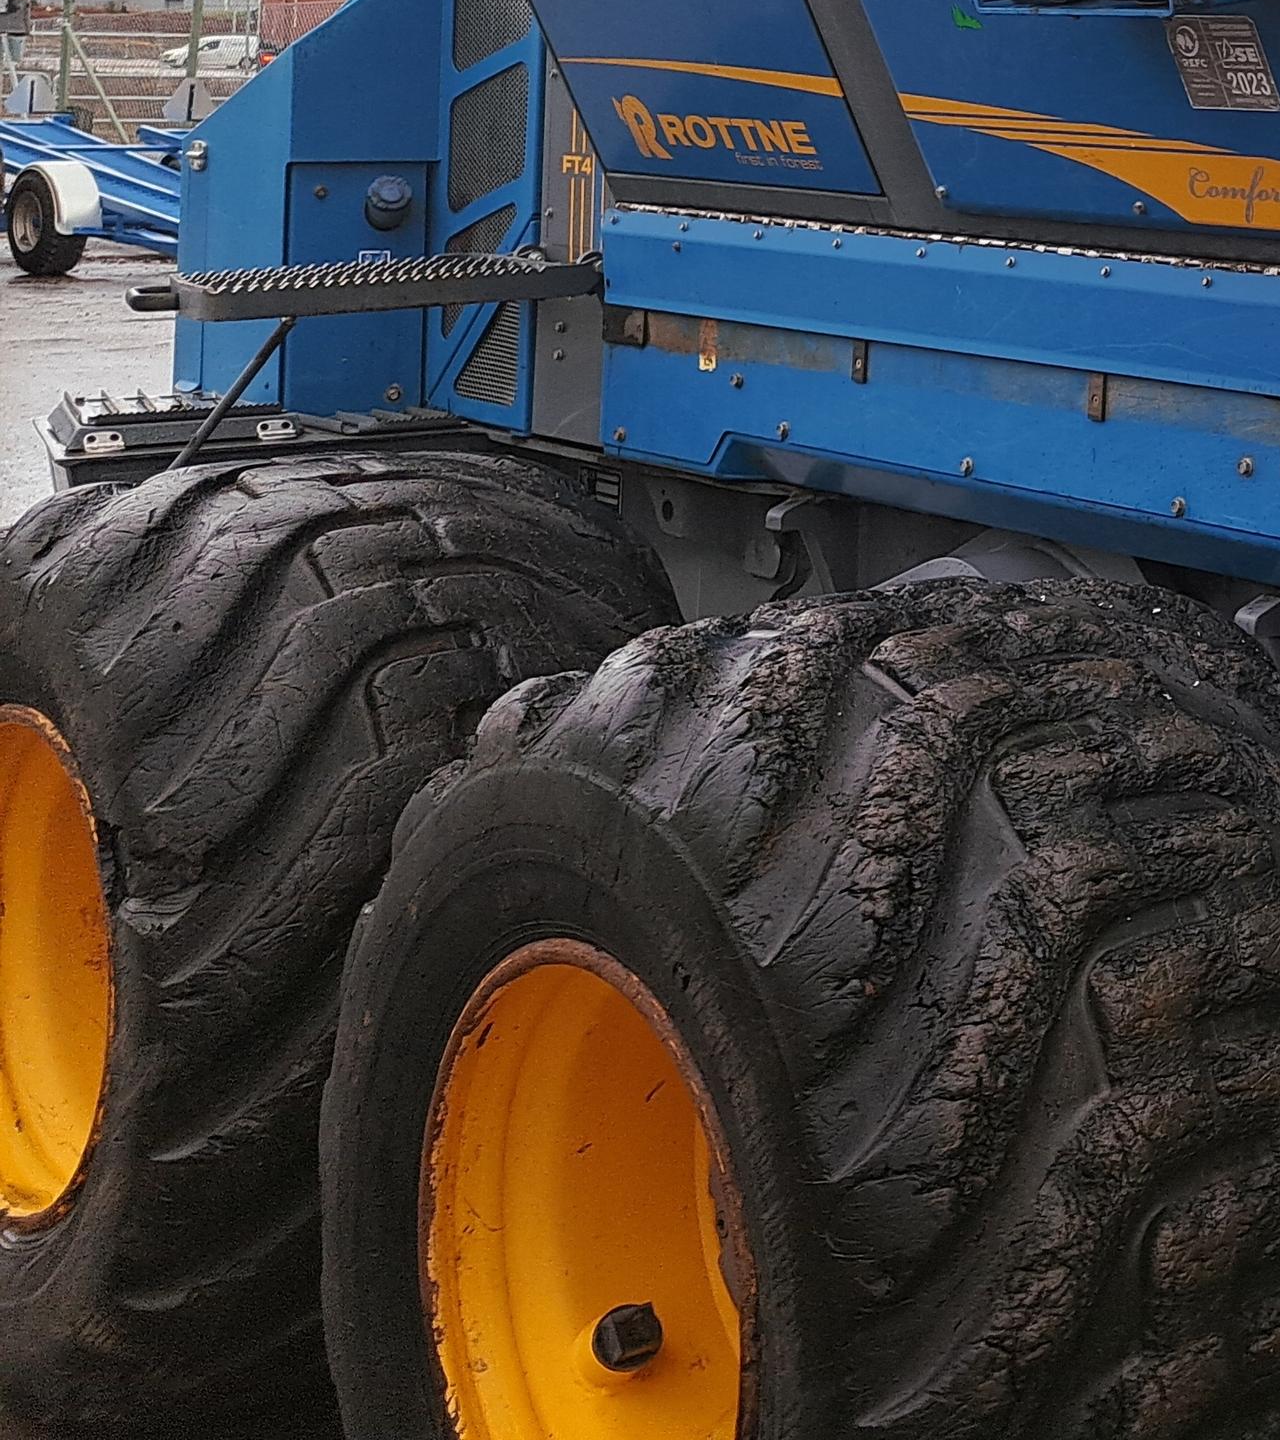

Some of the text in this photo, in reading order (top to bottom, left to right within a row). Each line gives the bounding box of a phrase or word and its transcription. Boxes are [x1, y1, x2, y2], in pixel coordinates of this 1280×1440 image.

[1227, 71, 1271, 96] 2023
[657, 113, 817, 155] ROTTNE
[562, 154, 592, 175] FT4
[780, 155, 824, 171] forest
